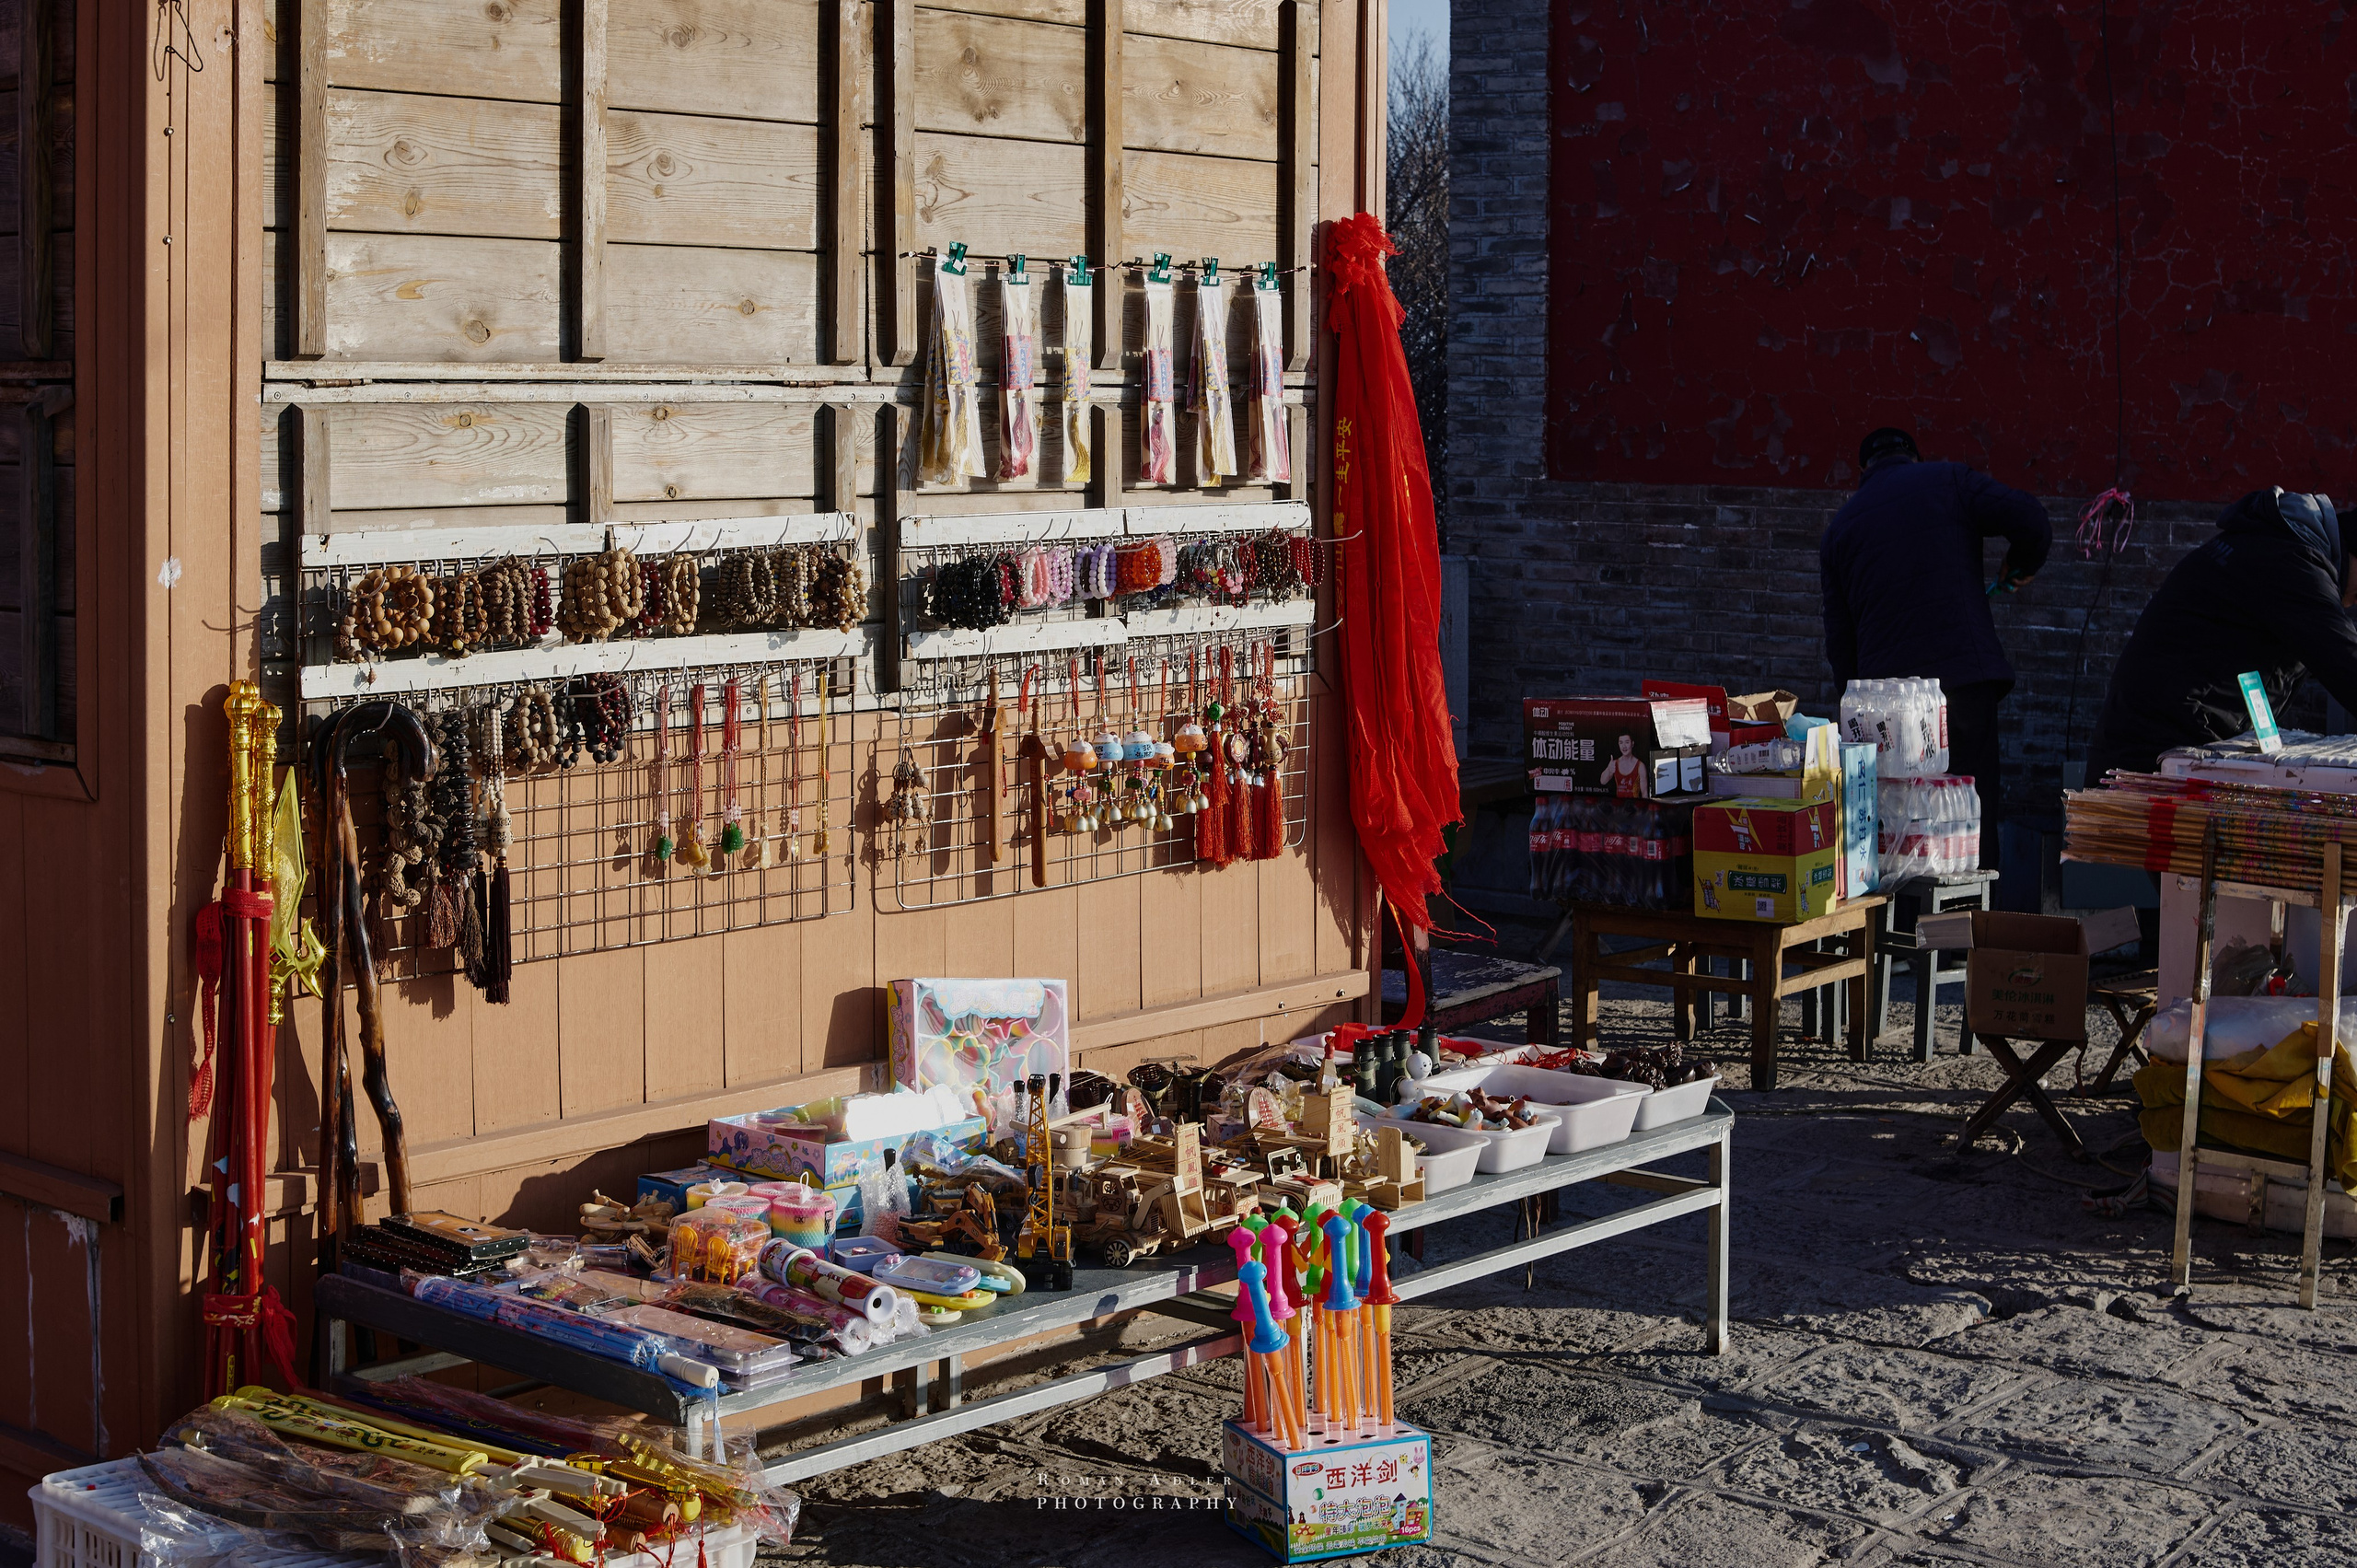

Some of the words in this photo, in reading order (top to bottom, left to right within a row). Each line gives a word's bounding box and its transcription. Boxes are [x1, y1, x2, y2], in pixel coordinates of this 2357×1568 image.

[1335, 416, 1353, 506] 一生平安
[1531, 737, 1596, 761] 体动能量
[1733, 875, 1782, 890] 冰糖雪梨
[1991, 988, 2055, 1005] 美伦冰淇淋
[1247, 1442, 1275, 1478] 西洋剑
[1325, 1459, 1398, 1490] 西洋剑
[1318, 1494, 1392, 1523] 特大泡泡
[1399, 1525, 1422, 1535] 16pcs
